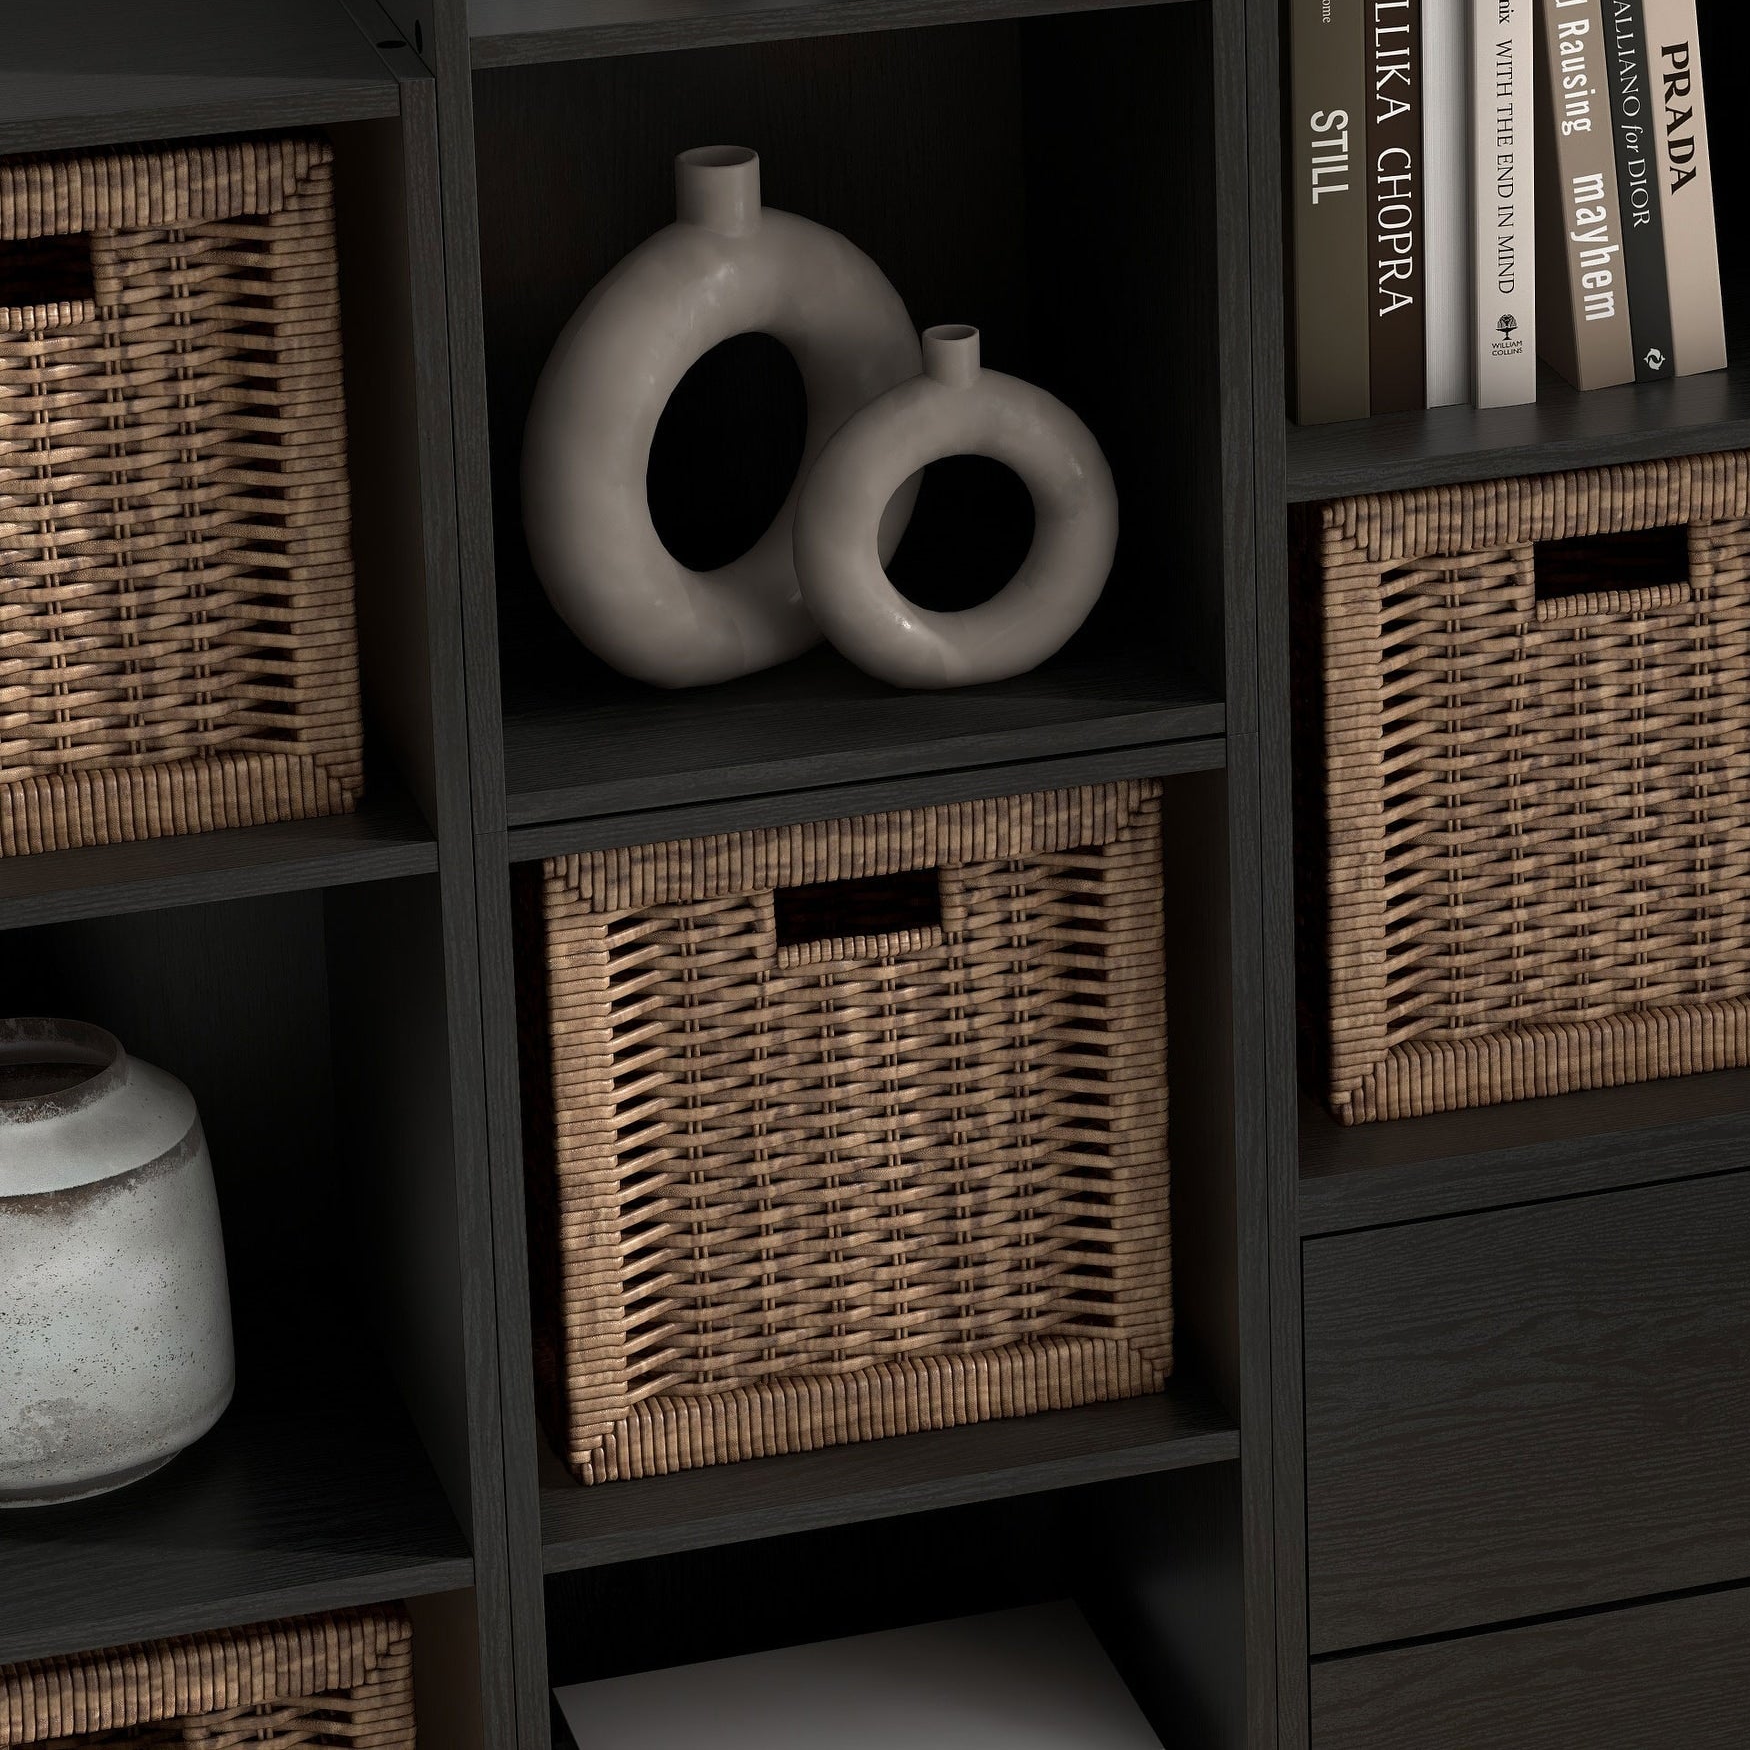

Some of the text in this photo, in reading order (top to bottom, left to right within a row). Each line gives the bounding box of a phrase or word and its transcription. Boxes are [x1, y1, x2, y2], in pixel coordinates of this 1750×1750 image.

[1495, 39, 1513, 97] WITH
[1557, 18, 1597, 137] Rausing
[1497, 103, 1514, 147] THE
[1621, 124, 1644, 153] for
[1661, 40, 1697, 195] PRADA
[1310, 109, 1350, 205] STILL
[1497, 153, 1514, 199] END
[1497, 205, 1514, 228] IN
[1628, 158, 1650, 228] DIOR
[1377, 147, 1414, 318] CHOPRA
[1570, 172, 1620, 321] mayhem
[1498, 234, 1515, 295] MIND
[1491, 340, 1523, 349] WILLIAM
[1491, 347, 1523, 357] COLLINS
